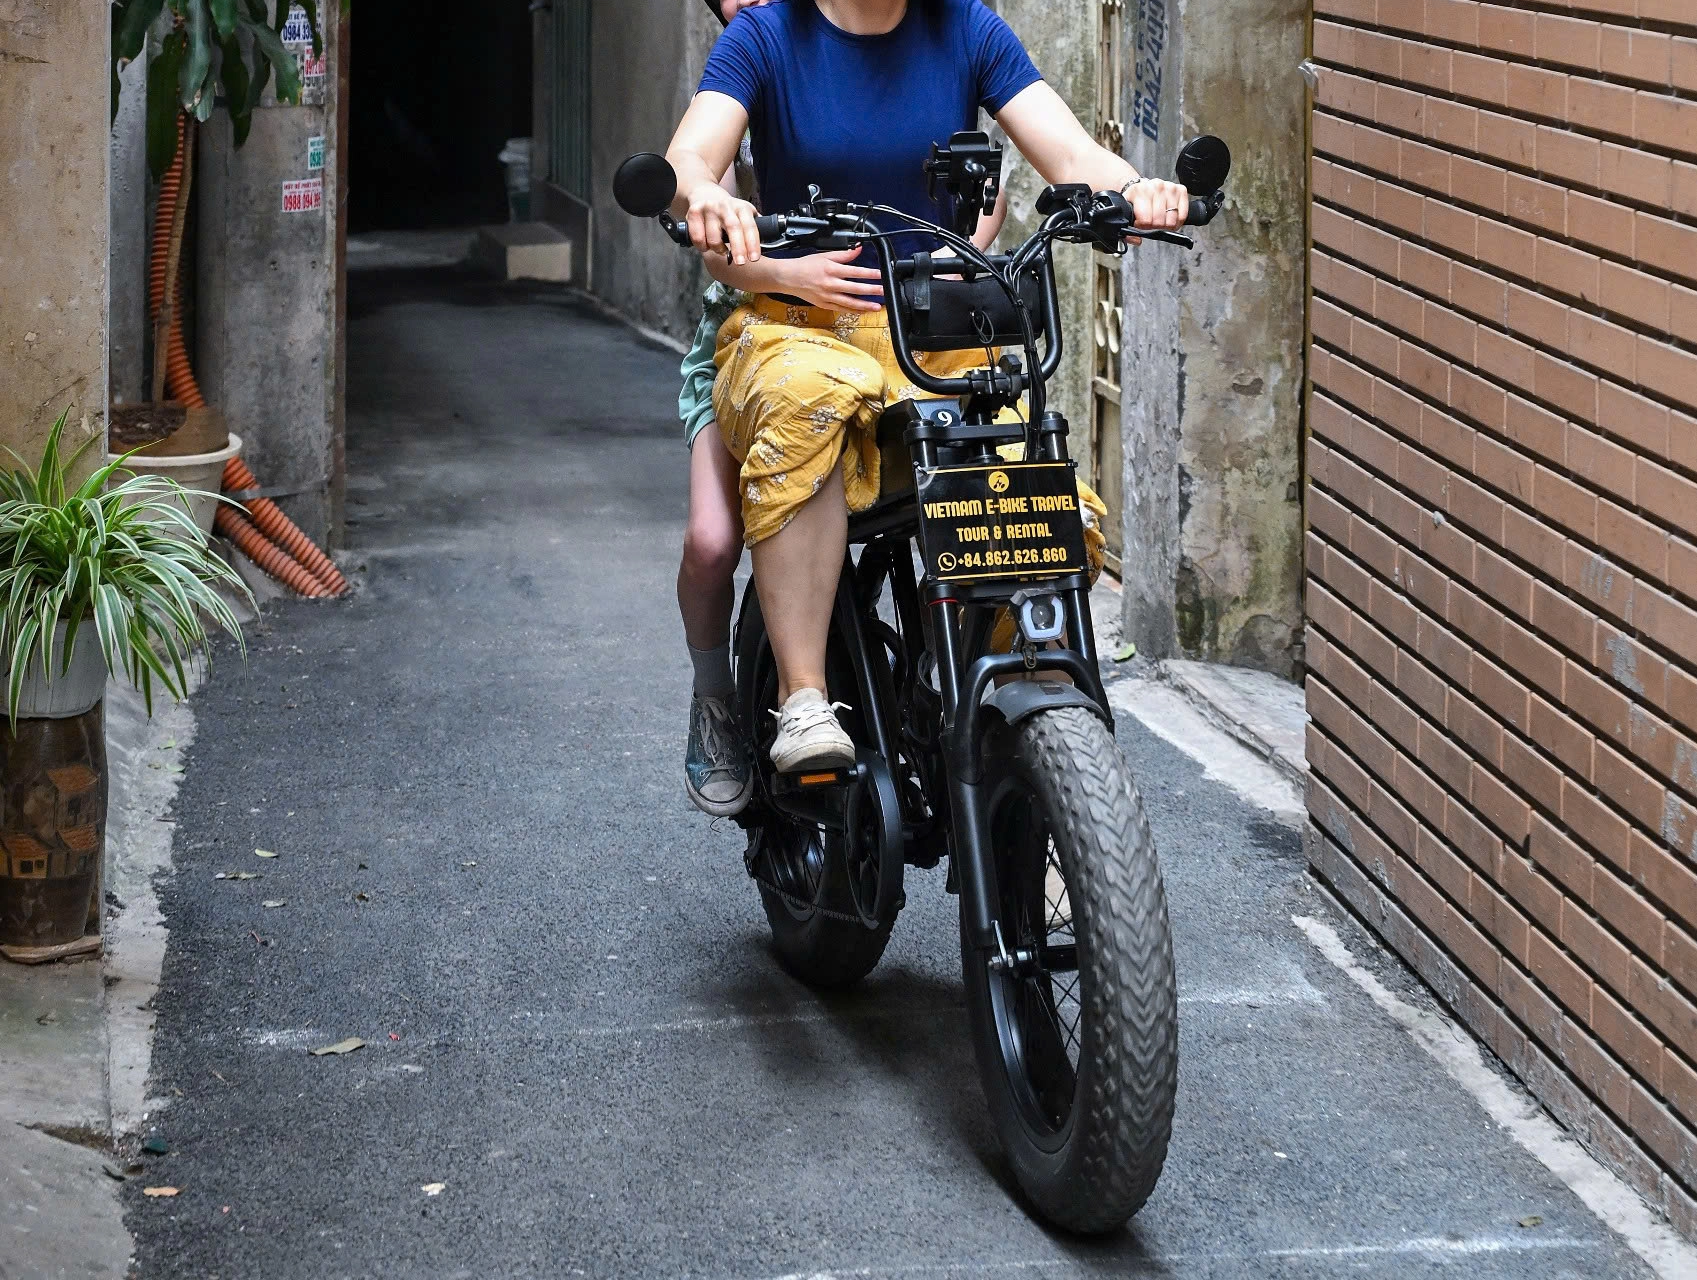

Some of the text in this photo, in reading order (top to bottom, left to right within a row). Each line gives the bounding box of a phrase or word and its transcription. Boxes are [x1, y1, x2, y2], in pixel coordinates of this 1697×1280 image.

[938, 411, 952, 427] 9
[924, 495, 1077, 519] VIETNAM E-BIKE TRAVEL
[956, 522, 1053, 543] TOUR & RENTAL
[958, 547, 1067, 568] +84.862.626.860
